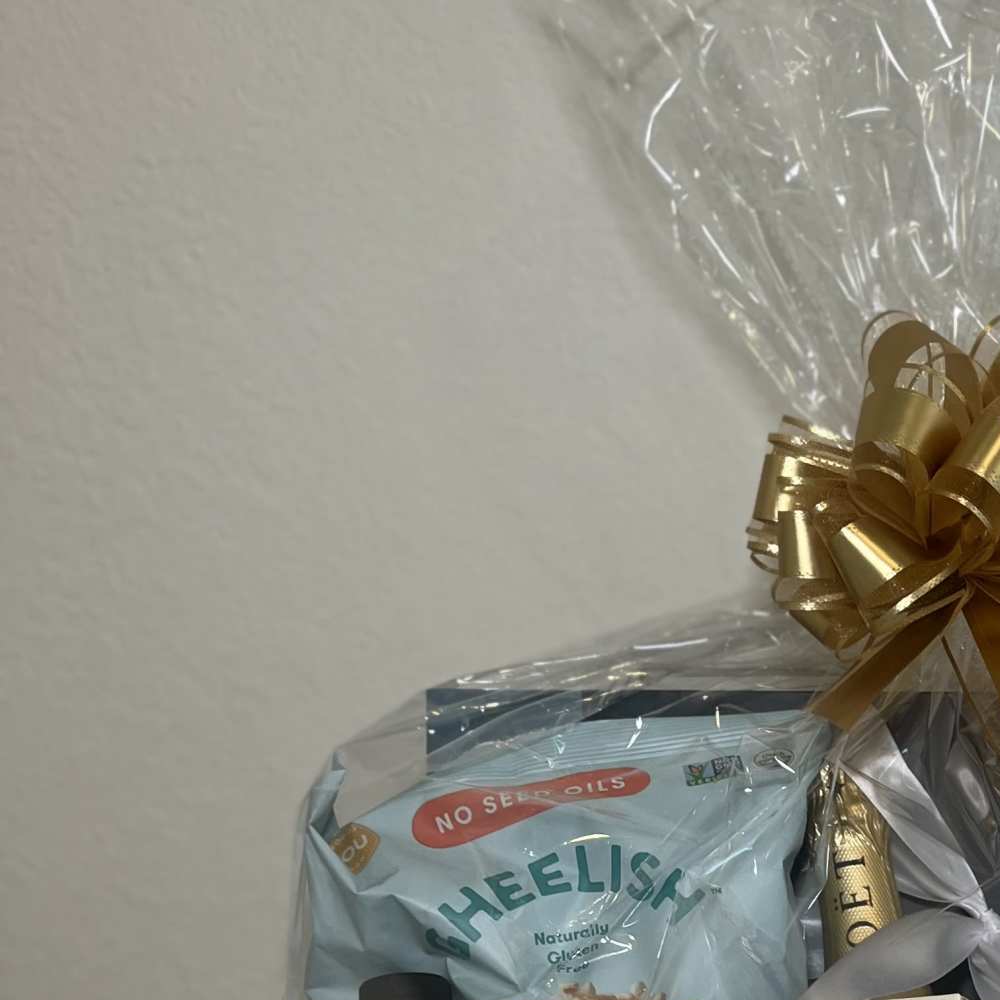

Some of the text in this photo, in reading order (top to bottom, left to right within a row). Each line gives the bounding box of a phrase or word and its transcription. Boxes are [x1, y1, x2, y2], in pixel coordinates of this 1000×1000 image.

[434, 805, 473, 834] NO
[564, 776, 625, 796] OILS
[834, 852, 880, 948] OËT
[533, 923, 609, 946] Naturally
